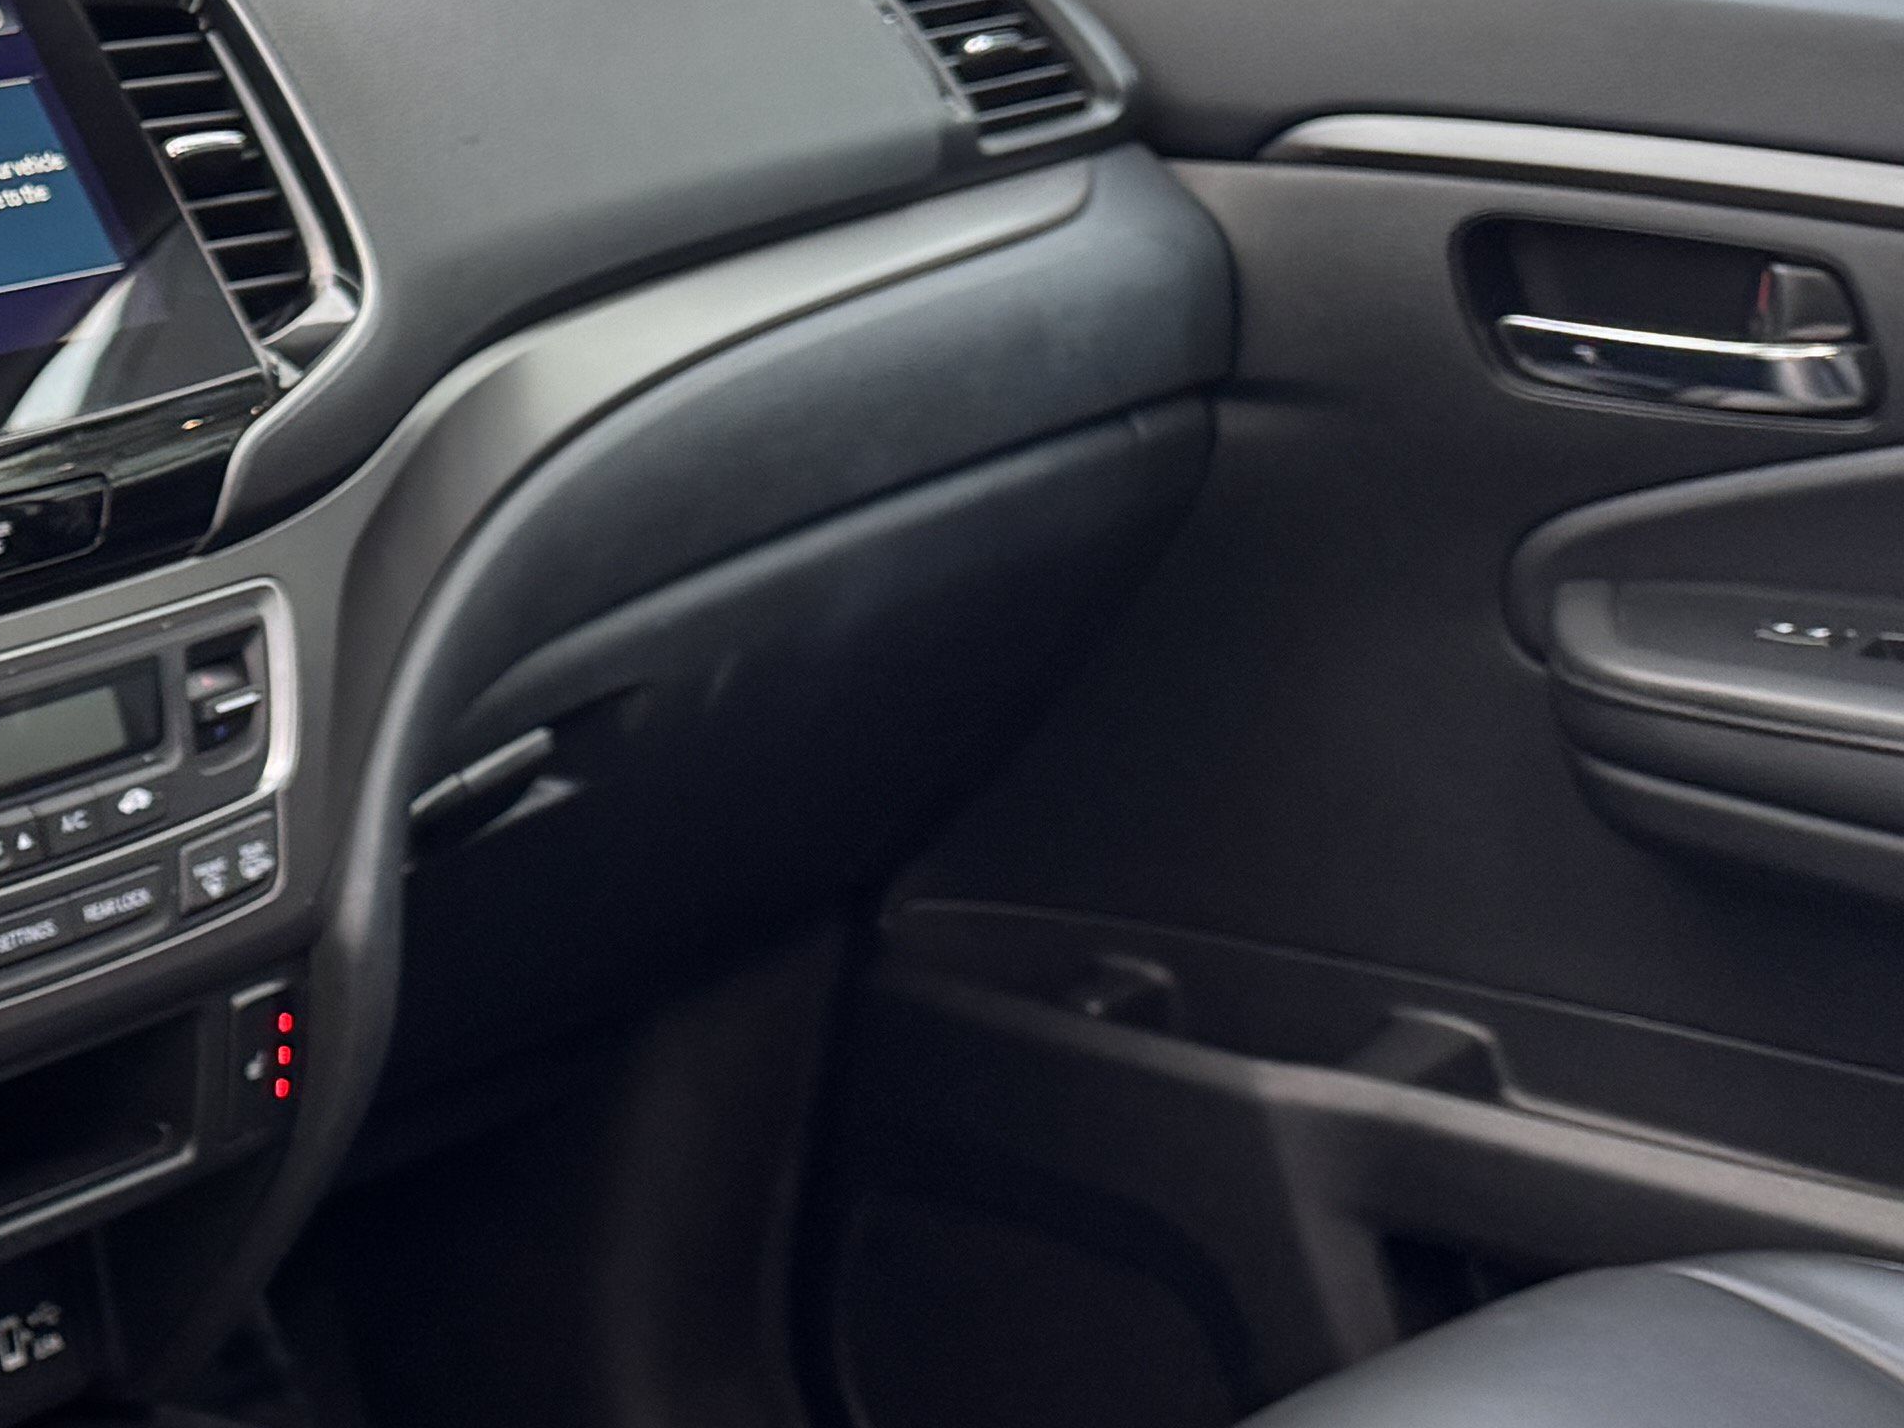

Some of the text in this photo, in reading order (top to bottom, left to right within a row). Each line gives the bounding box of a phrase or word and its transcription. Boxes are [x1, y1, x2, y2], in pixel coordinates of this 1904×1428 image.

[13, 151, 68, 177] vehicle
[2, 189, 22, 209] to
[21, 183, 52, 204] the
